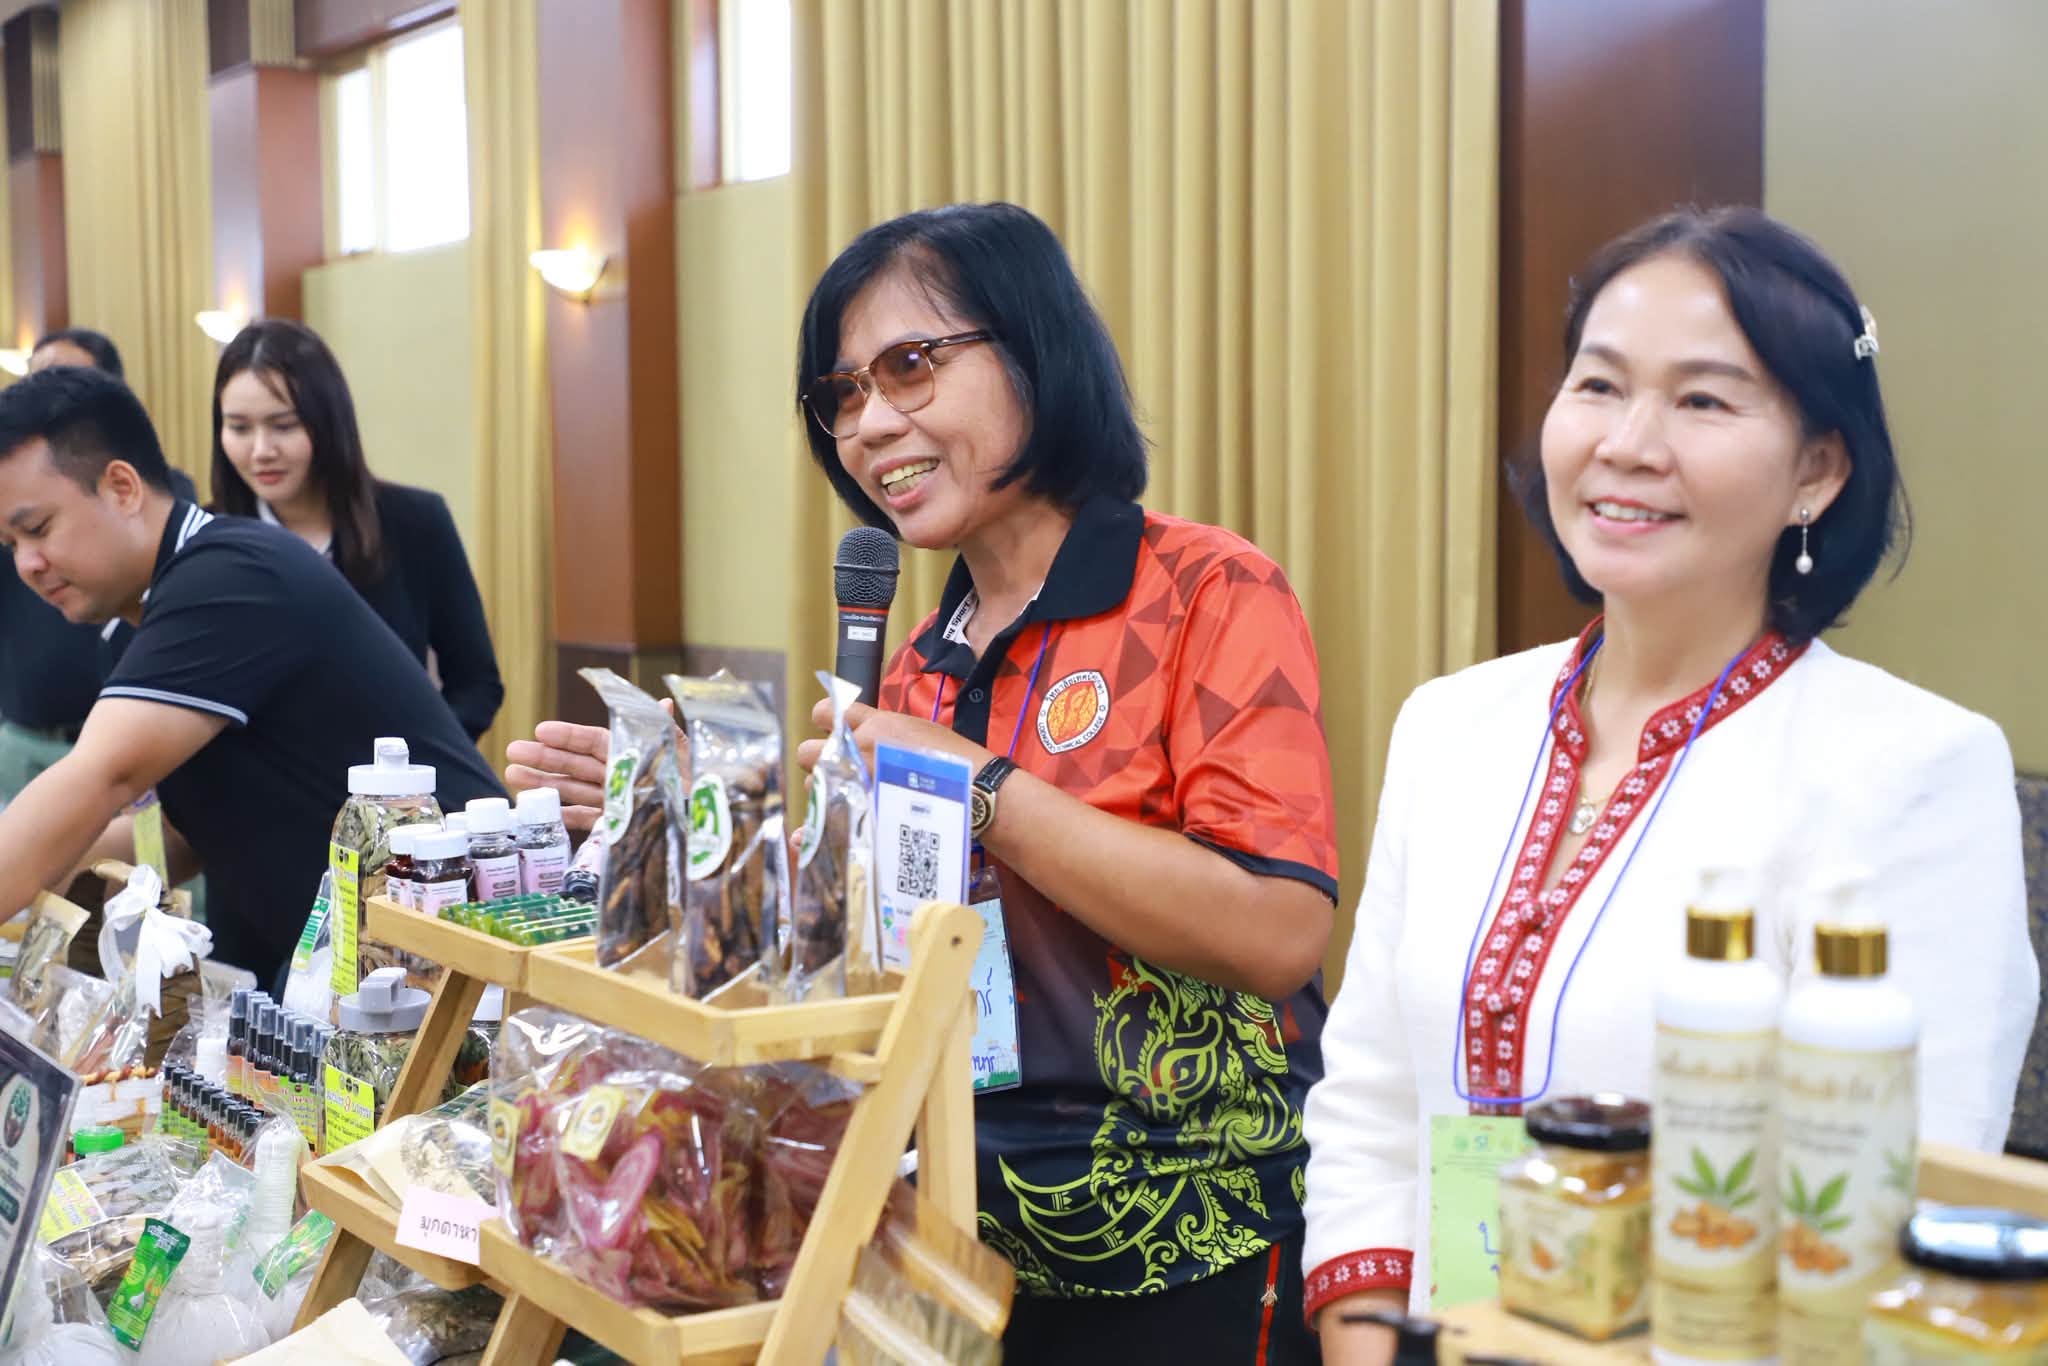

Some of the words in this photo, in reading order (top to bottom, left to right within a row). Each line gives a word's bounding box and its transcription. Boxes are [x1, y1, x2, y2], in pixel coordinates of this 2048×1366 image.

[1082, 717, 1105, 741] COLLEGE
[419, 1216, 478, 1243] มุกดาหา
